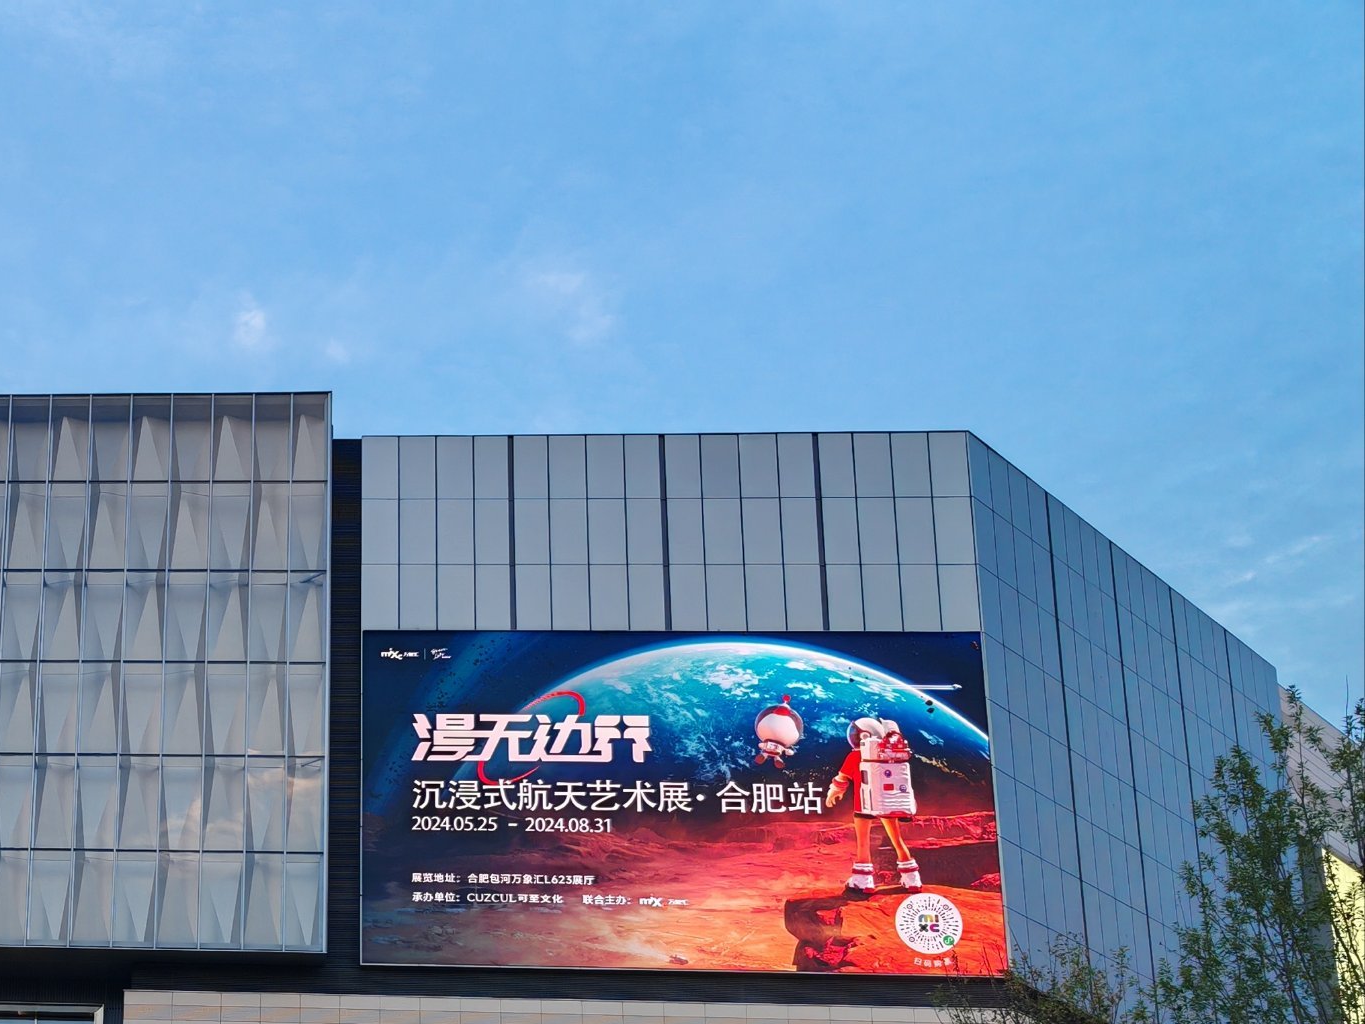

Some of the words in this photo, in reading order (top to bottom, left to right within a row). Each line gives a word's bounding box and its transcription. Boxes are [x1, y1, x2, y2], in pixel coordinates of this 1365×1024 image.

[411, 713, 652, 763] 漫无边界
[411, 816, 498, 831] 2024.05.25
[525, 817, 611, 833] 2024.08.31
